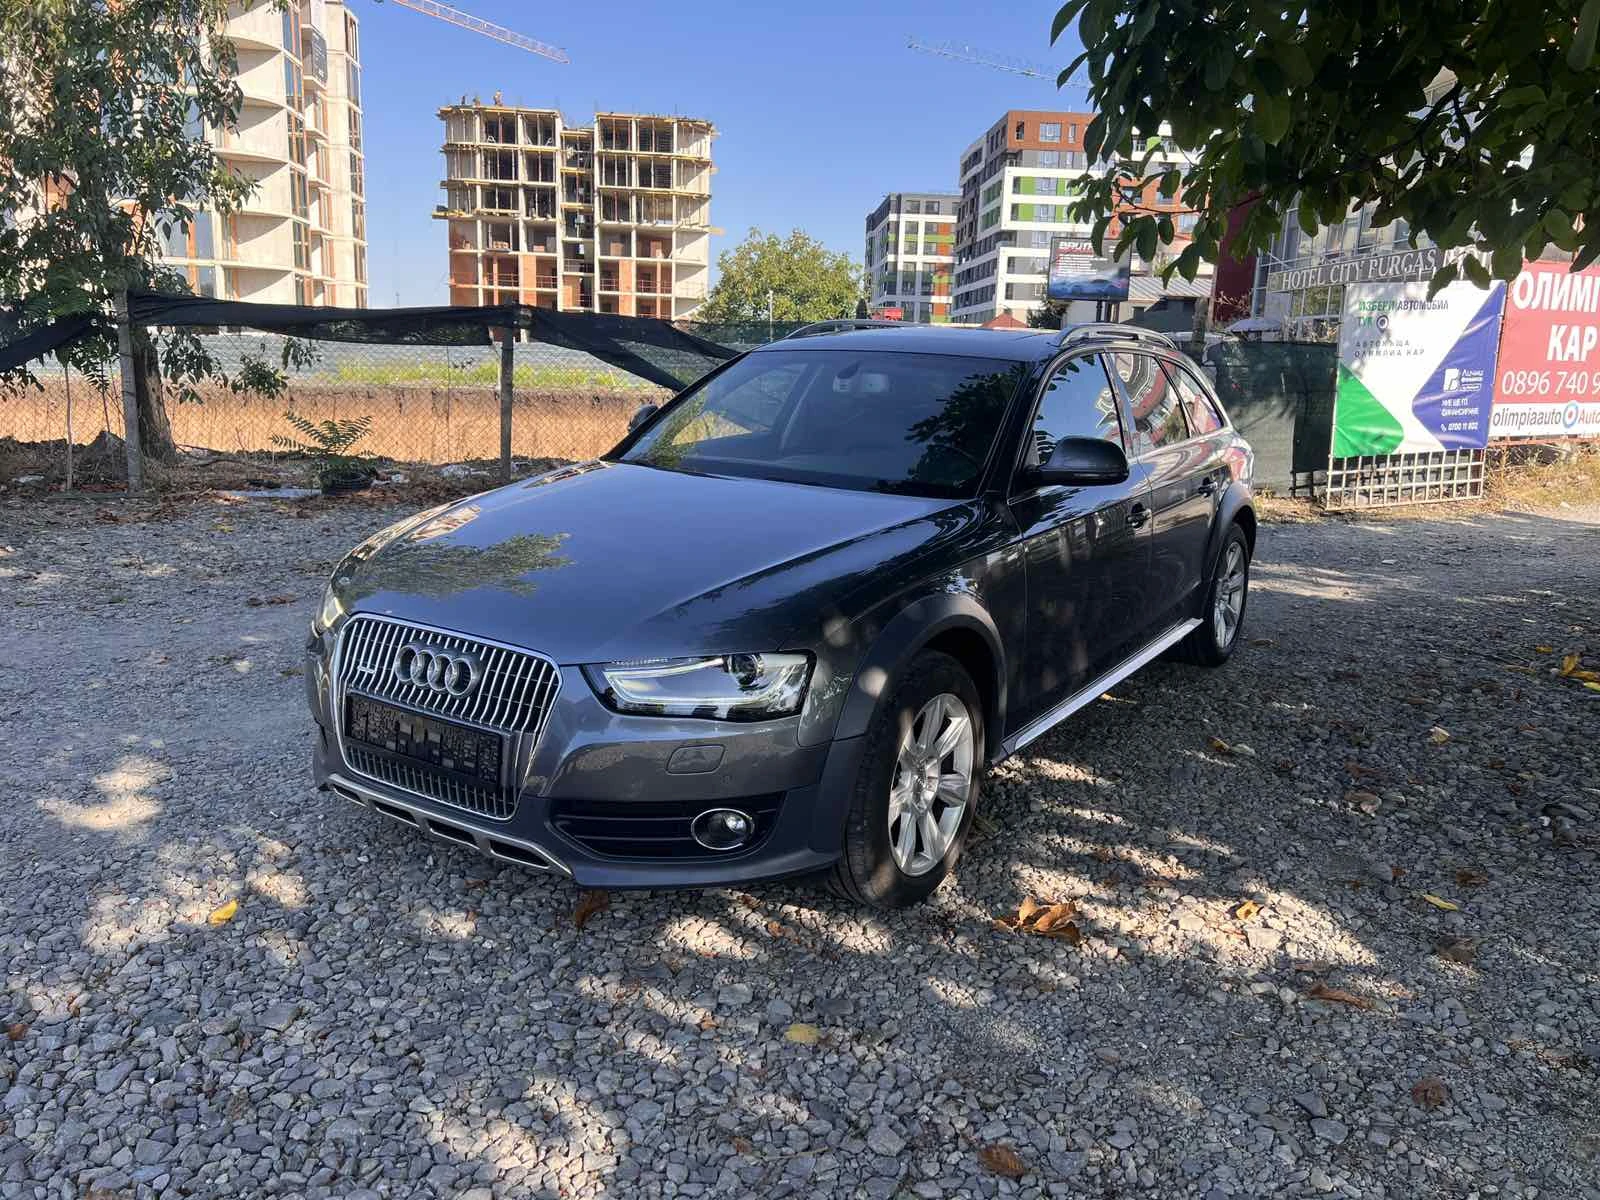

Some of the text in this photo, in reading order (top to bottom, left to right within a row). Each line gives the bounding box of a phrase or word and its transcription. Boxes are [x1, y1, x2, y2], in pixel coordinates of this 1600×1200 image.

[1281, 268, 1328, 290] HOTEL
[1330, 260, 1367, 284] CITY
[1396, 299, 1449, 311] АВТОМОБИЛ
[1547, 324, 1598, 361] КАР
[1502, 371, 1551, 395] 0896
[1555, 371, 1588, 395] 740
[1493, 408, 1561, 430] olimpiaauto
